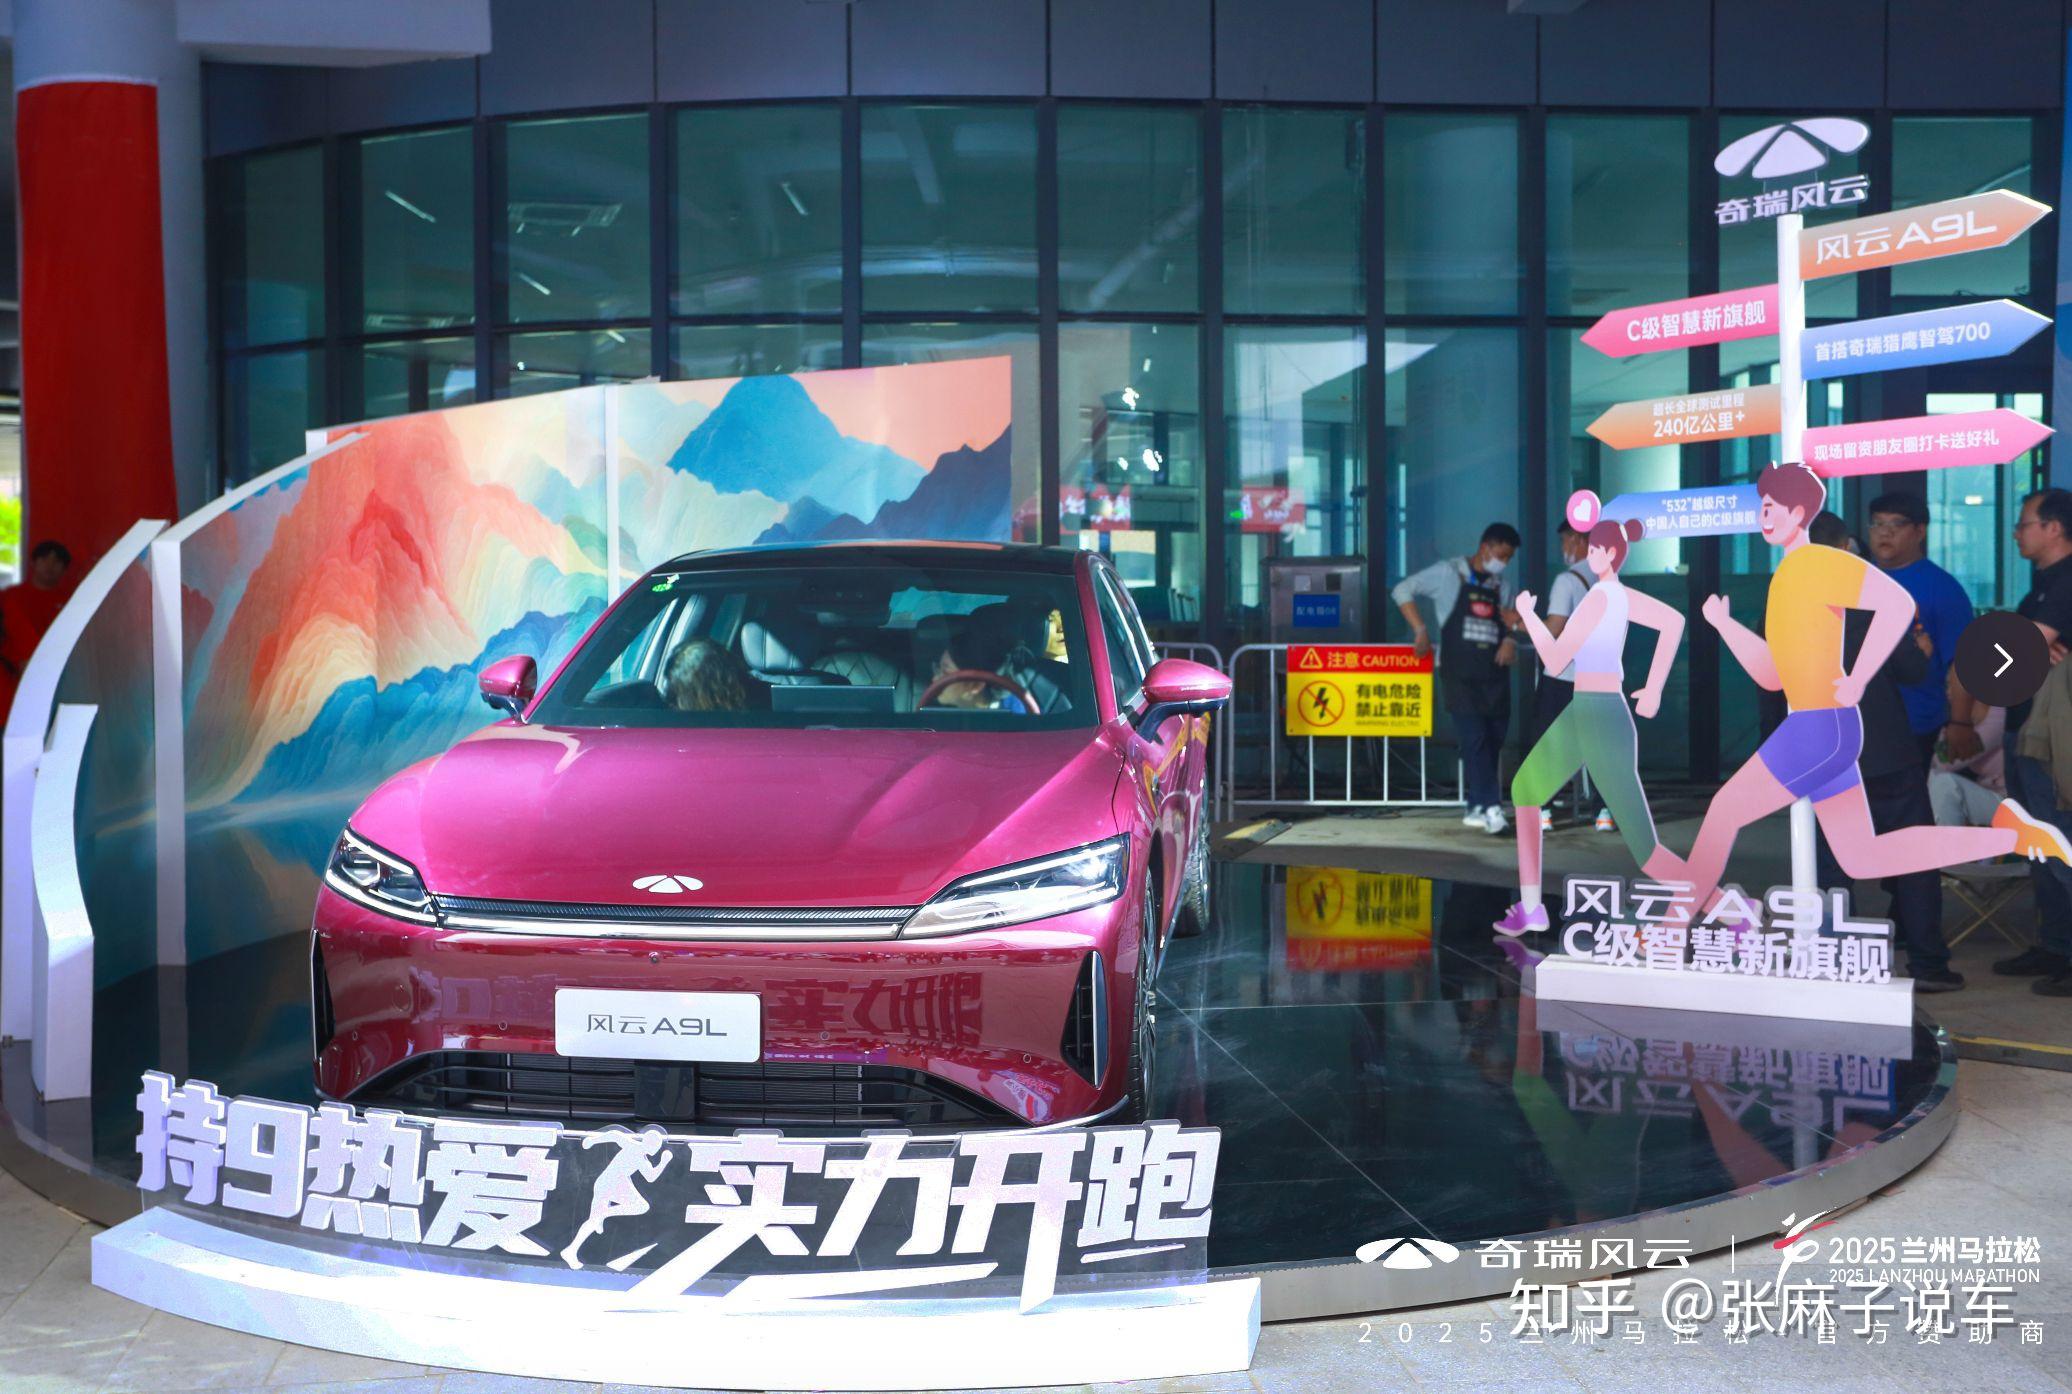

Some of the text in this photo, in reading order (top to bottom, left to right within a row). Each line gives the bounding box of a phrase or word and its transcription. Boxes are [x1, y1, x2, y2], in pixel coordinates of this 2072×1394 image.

[1715, 174, 1870, 224] 奇瑞风云
[1816, 211, 1997, 263] 风云A9L
[1627, 301, 1766, 341] C级智慧新旗舰
[1814, 322, 1991, 362] 首搭奇瑞猎鹰智驾700
[1814, 429, 2000, 461] 现场留资朋友圈打卡送好礼
[1327, 652, 1420, 668] 注意 CAUTION
[1356, 683, 1422, 699] 有电危险
[1356, 702, 1422, 718] 禁止靠近
[1564, 879, 1889, 935] 风云A9L
[1563, 922, 1891, 984] C级智慧新旗舰
[586, 1013, 728, 1037] 风云A9L
[136, 1070, 1222, 1314] 持9热爱 实力开跑
